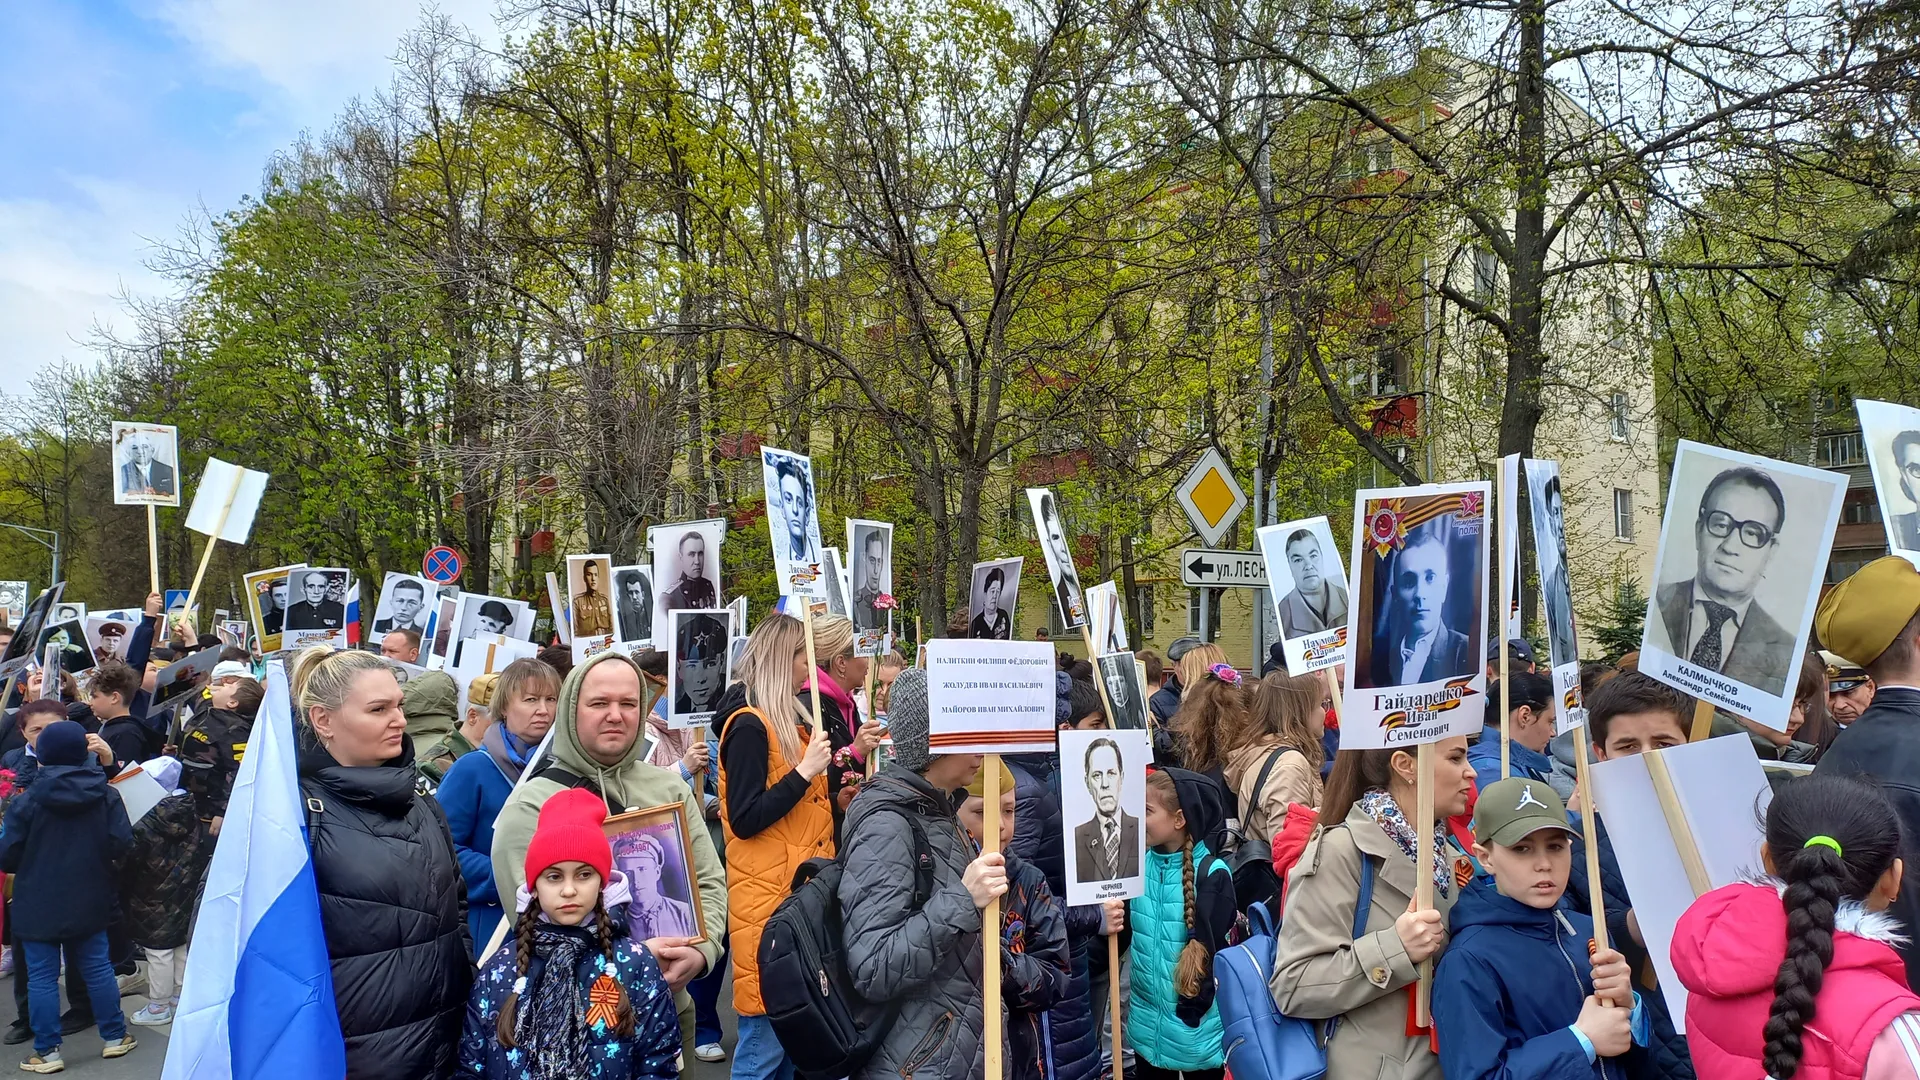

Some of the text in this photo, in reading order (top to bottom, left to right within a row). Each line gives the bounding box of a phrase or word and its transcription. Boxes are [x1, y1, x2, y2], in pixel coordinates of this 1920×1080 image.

[1459, 526, 1479, 535] ПОЛК
[1216, 563, 1233, 581] ул.
[1302, 634, 1341, 650] Наумова
[976, 657, 1007, 665] ФИЛИПП
[942, 682, 978, 690] ЖОЛУДЕВ
[998, 681, 1043, 689] ВАСИЛЬЕВИЧ
[1677, 664, 1738, 696] КАЛМЫЧКОВ
[1662, 669, 1752, 713] Александр Семёнович
[1373, 686, 1462, 711] Гайдаренко
[941, 704, 977, 713] МАЙОРОВ
[997, 704, 1045, 713] МИХАЙЛОВИЧ
[1406, 711, 1438, 724] Иван
[1386, 723, 1450, 742] Семенович
[1101, 882, 1123, 891] ЧЕРНЯЕВ
[1107, 890, 1128, 899] Егорович
